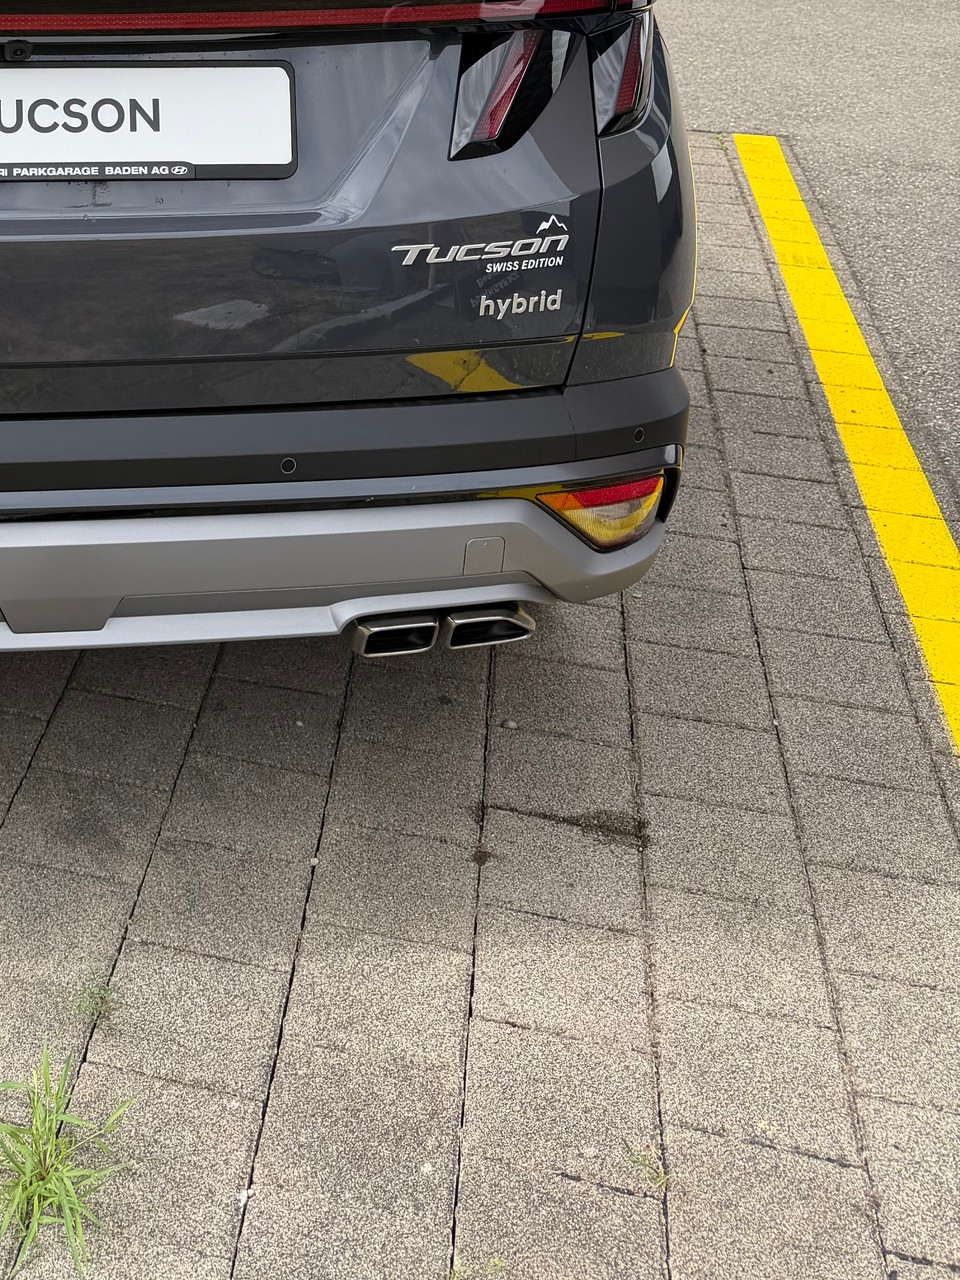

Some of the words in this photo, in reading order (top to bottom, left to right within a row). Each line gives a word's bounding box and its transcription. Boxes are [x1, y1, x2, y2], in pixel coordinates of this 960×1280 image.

[12, 166, 99, 177] PARKGARAGE
[105, 166, 148, 176] BADEN
[151, 165, 170, 175] AG
[485, 261, 520, 273] SWISS
[521, 256, 564, 270] EDITION
[479, 288, 563, 320] hybrid
